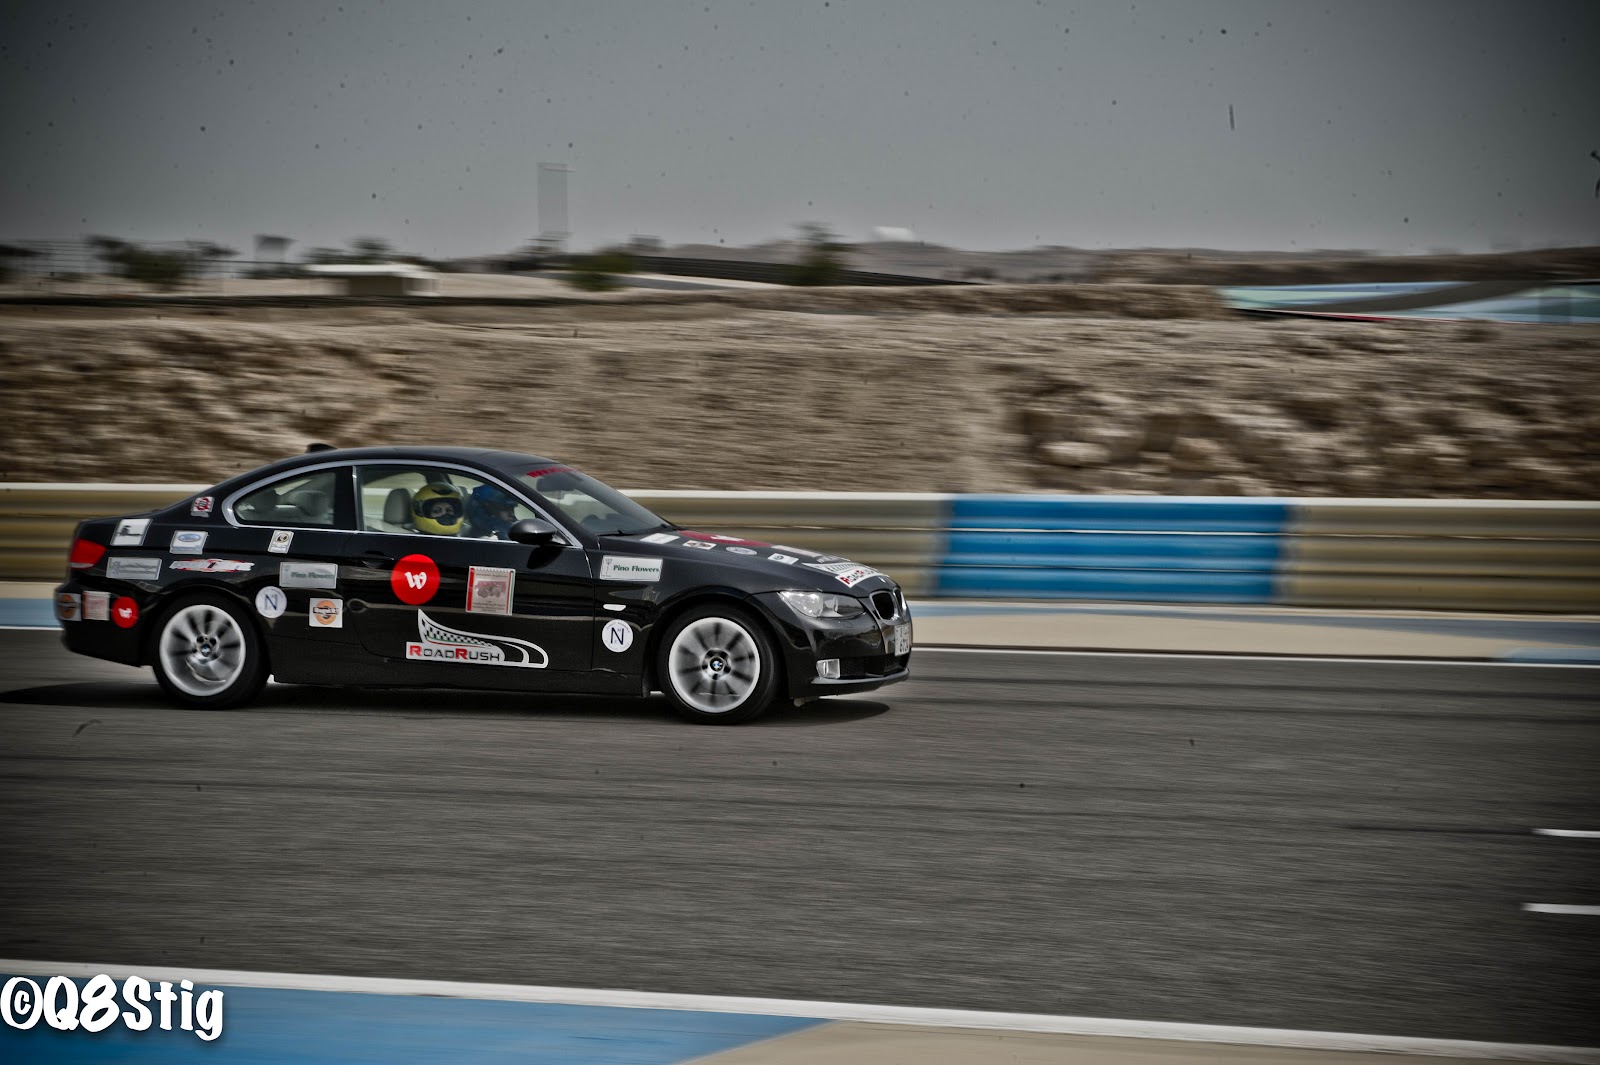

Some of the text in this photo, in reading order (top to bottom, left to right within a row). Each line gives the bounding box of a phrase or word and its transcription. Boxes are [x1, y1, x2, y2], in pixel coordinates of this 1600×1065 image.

[613, 564, 660, 573] Pino Flowers
[610, 627, 625, 646] N
